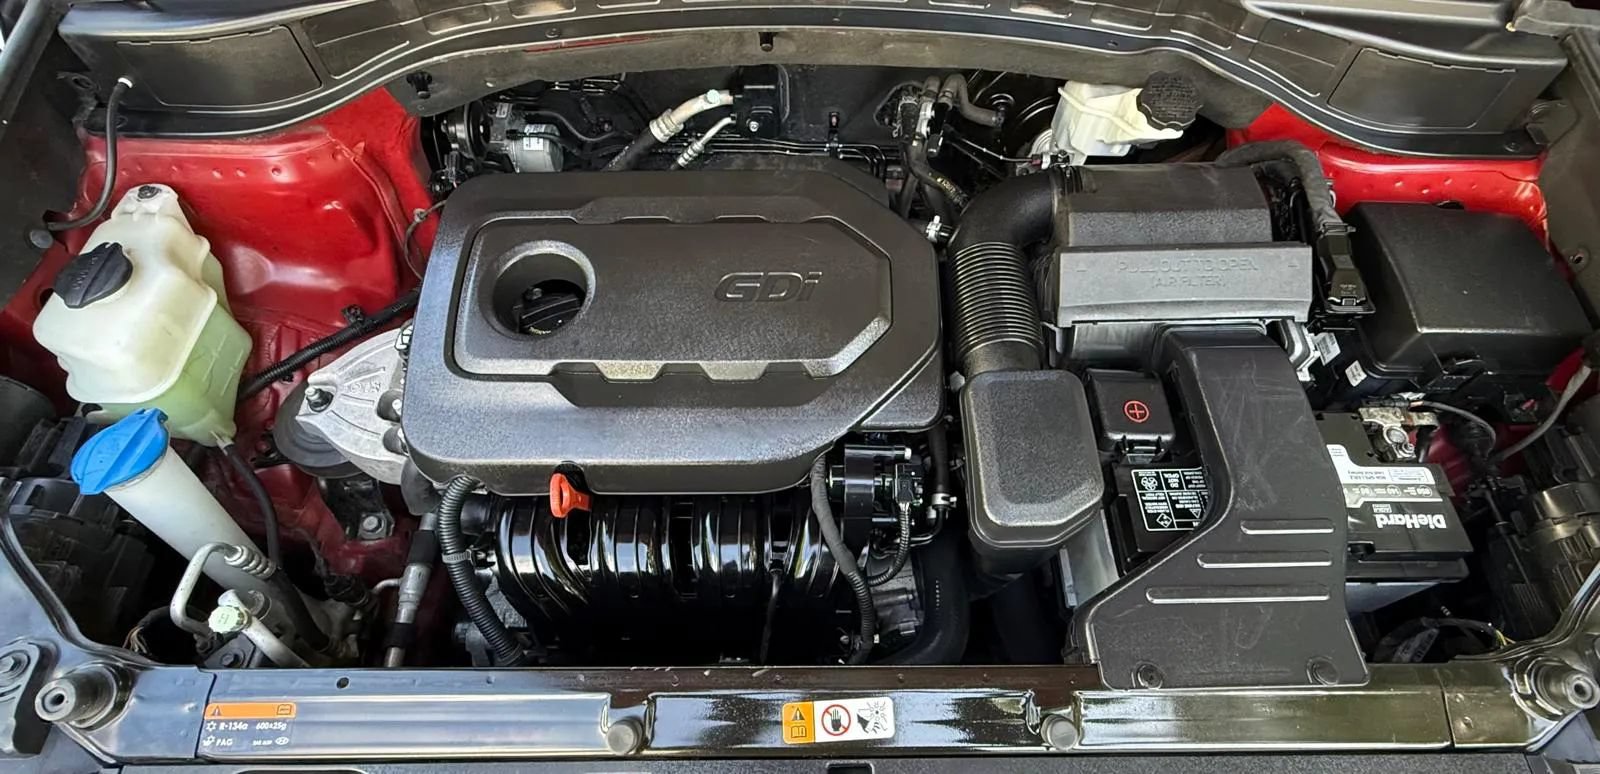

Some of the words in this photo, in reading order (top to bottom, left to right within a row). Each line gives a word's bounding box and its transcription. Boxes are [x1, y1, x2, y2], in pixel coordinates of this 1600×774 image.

[1217, 258, 1260, 272] OPEN
[714, 271, 823, 302] GDi
[1375, 514, 1447, 529] DieHard
